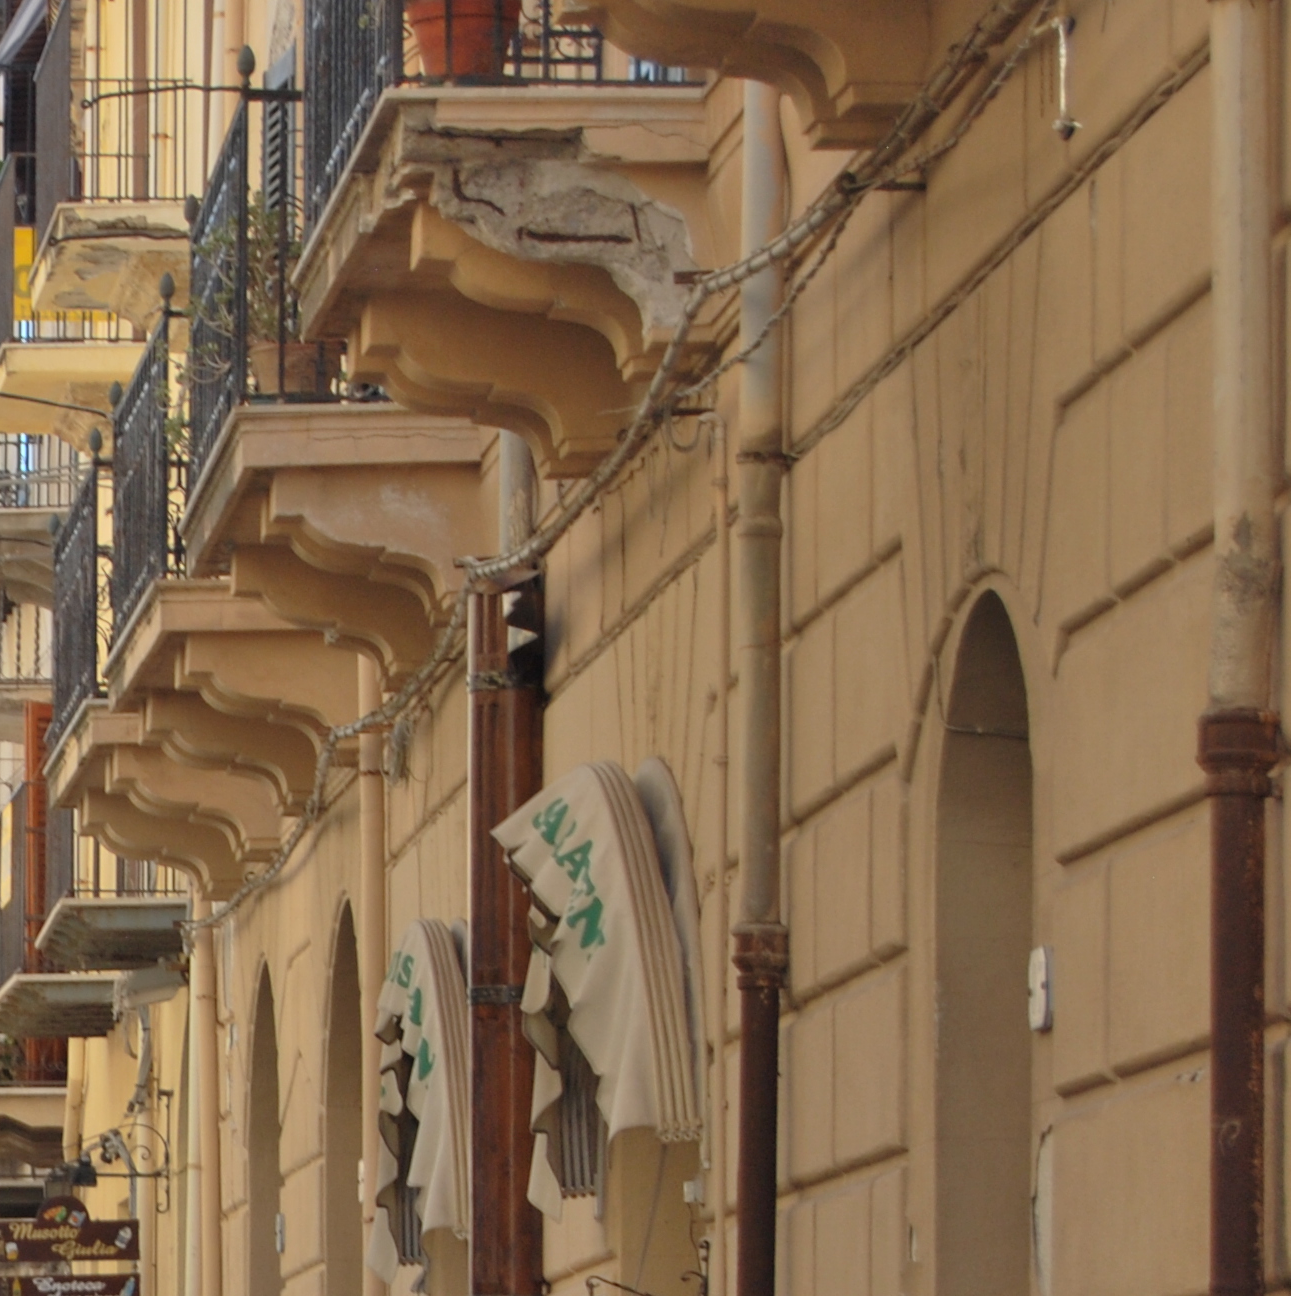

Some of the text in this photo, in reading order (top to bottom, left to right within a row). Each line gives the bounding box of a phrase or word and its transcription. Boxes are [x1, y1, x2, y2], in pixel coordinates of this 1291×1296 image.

[8, 1222, 81, 1241] Musotto
[50, 1239, 118, 1260] Giulia
[32, 1276, 107, 1293] Enoteca
